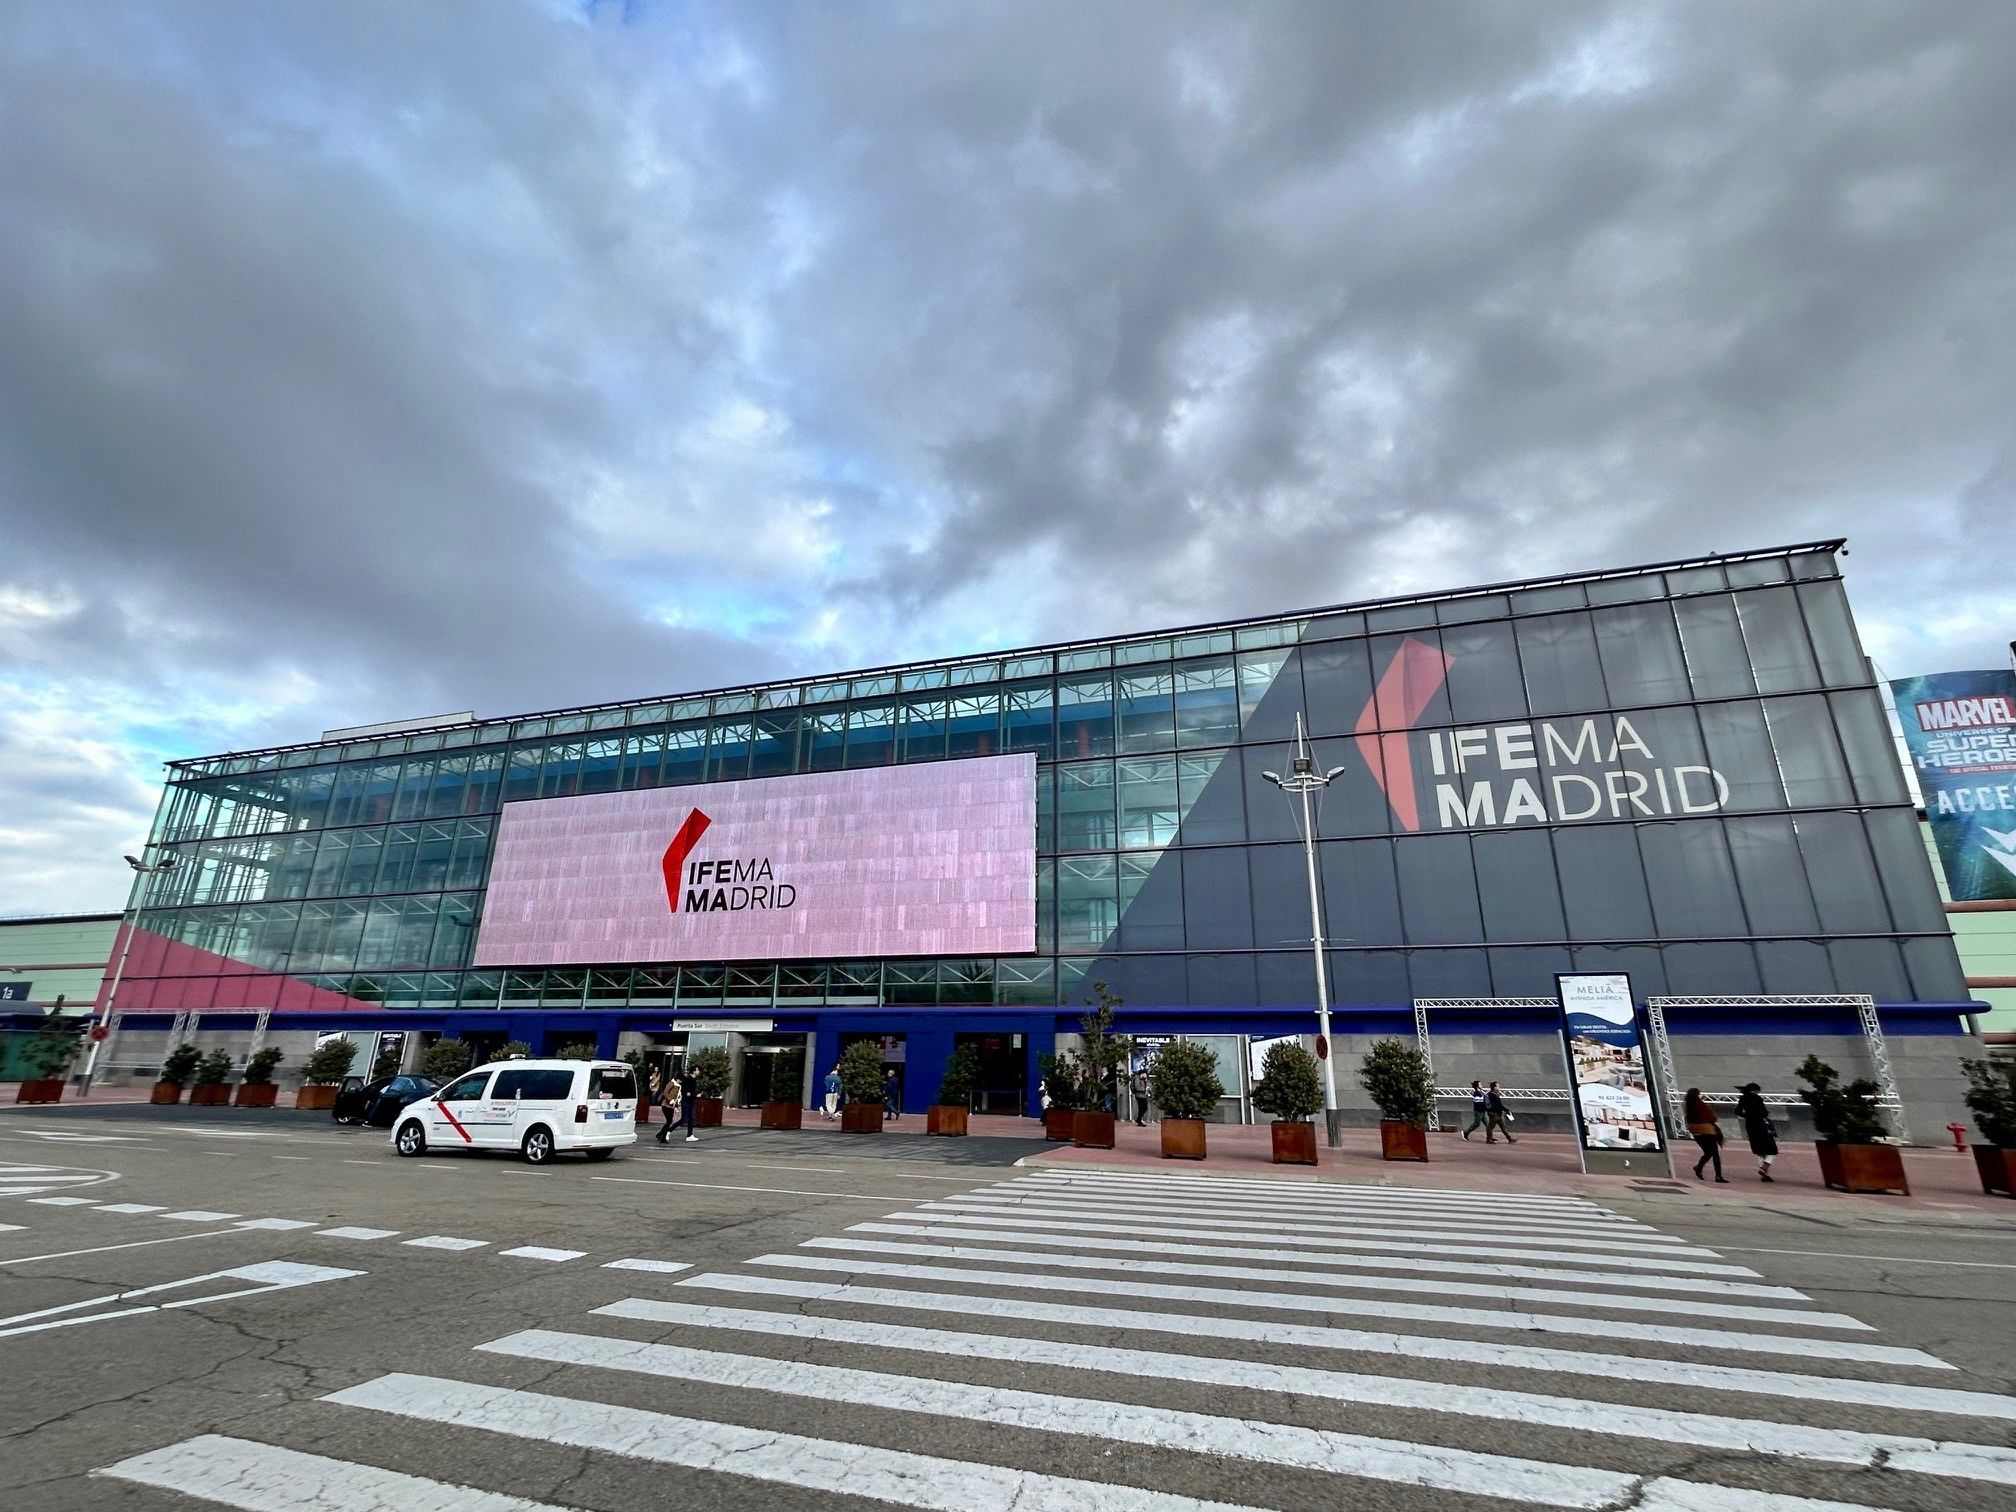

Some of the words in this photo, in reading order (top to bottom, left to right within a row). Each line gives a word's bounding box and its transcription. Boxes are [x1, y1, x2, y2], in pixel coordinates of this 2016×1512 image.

[1917, 697, 2016, 730] MARVEL
[1428, 716, 1655, 775] IFEMA
[1435, 765, 1730, 828] MADRID
[1937, 785, 2016, 814] ACCE
[688, 857, 773, 885] IFEMA
[685, 884, 796, 913] MADRID
